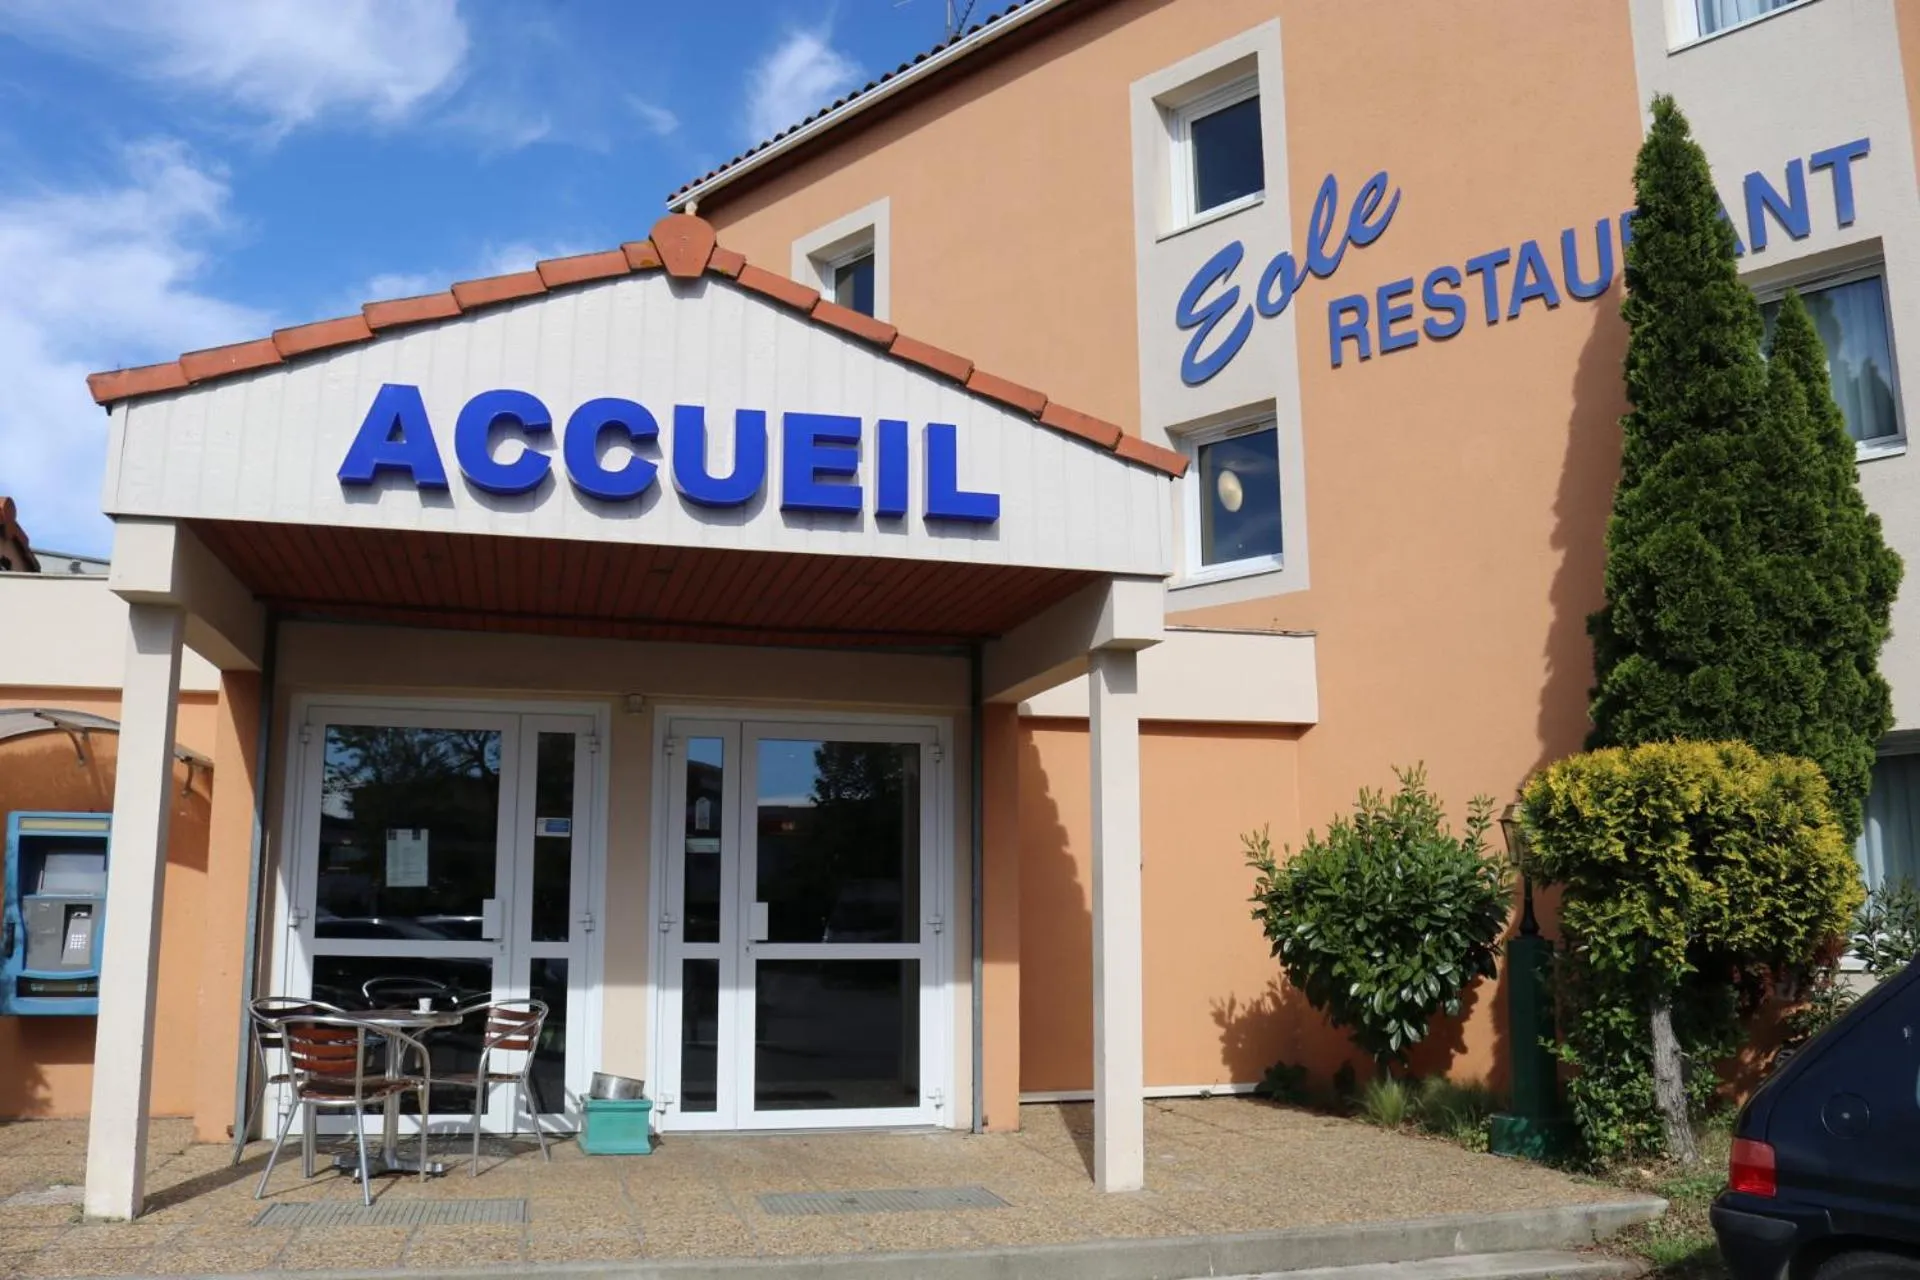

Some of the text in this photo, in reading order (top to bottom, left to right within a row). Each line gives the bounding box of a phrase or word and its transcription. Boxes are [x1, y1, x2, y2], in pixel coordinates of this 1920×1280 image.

[1176, 171, 1400, 386] Eole
[1328, 138, 1870, 368] RESTAUNT
[337, 383, 1000, 524] ACCUEIL
